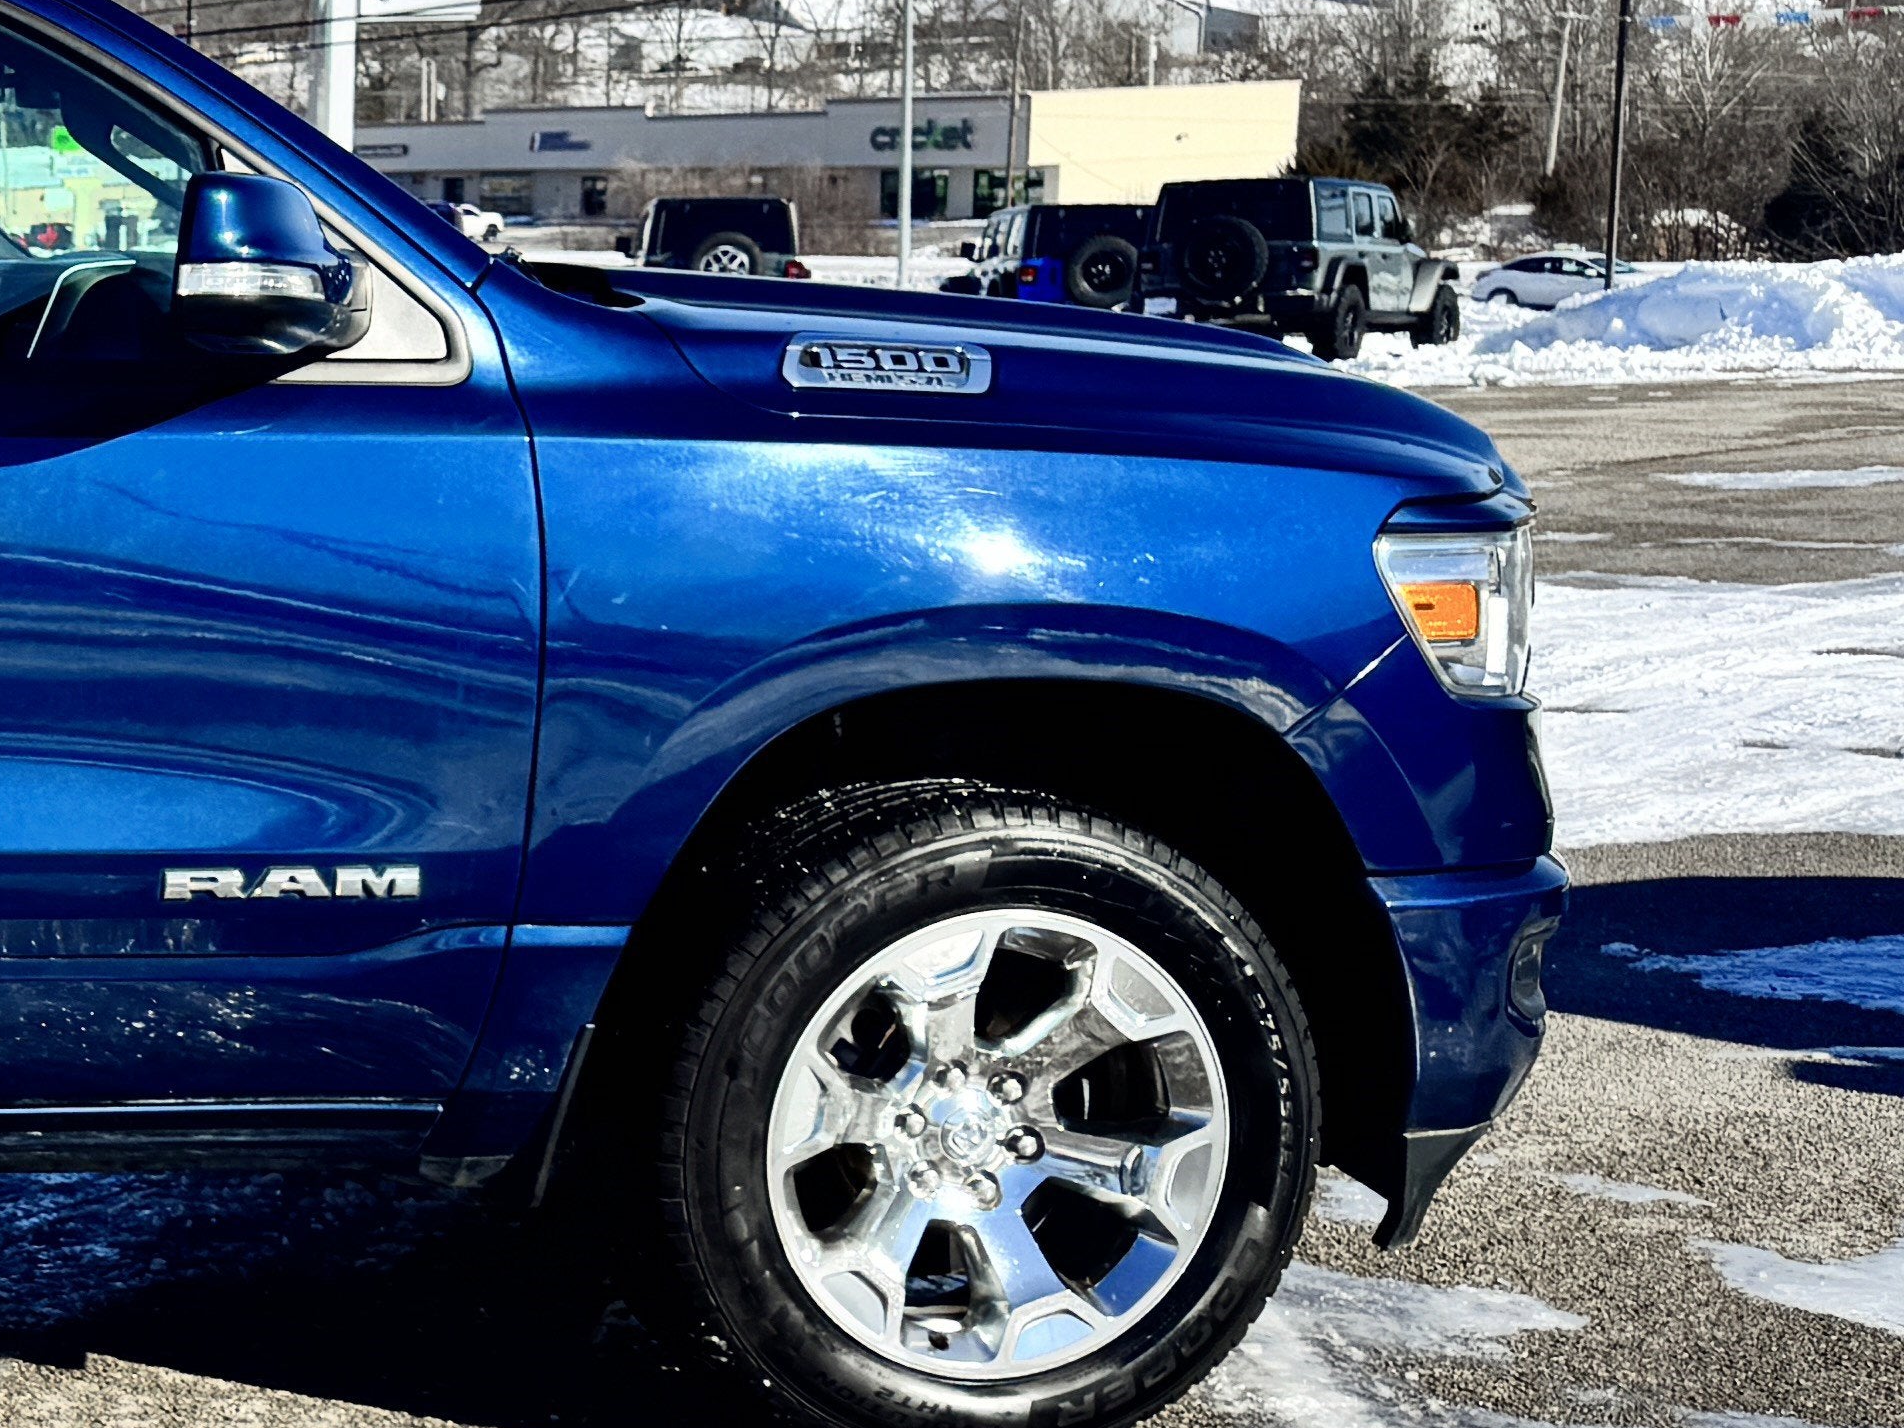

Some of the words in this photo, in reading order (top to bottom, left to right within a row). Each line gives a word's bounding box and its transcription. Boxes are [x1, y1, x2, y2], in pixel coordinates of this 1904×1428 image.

[870, 117, 974, 152] crcket
[812, 346, 962, 373] 1500
[162, 865, 421, 901] RAM
